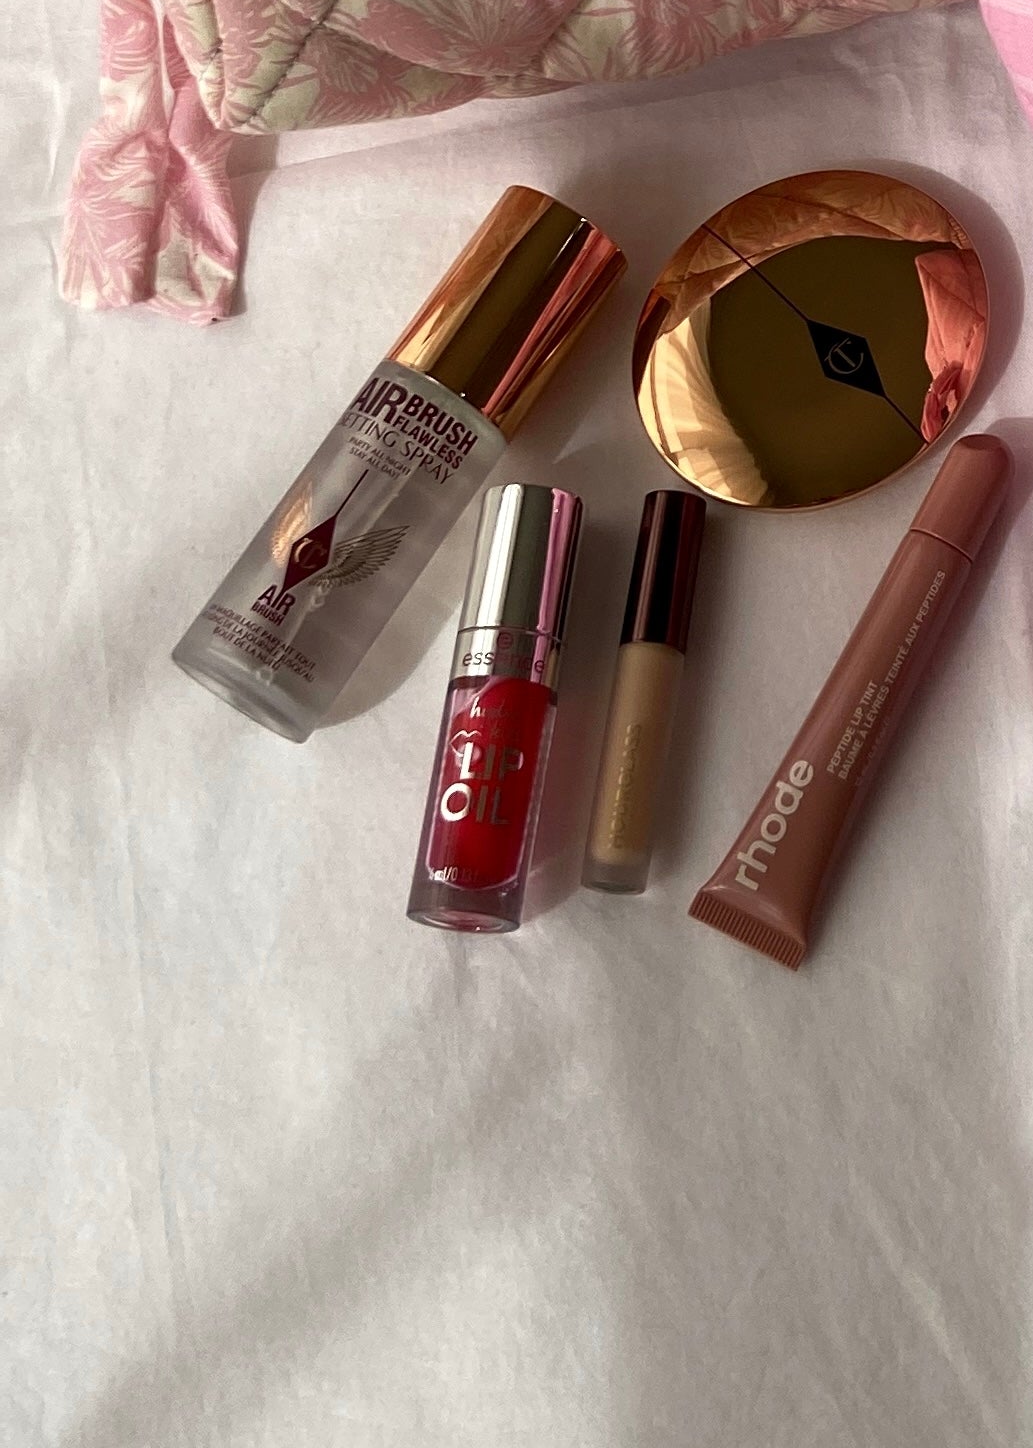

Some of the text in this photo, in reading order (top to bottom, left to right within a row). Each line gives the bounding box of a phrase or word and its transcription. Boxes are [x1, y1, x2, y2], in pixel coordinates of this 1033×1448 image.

[348, 436, 372, 451] PARTY
[372, 446, 387, 460] ALL
[349, 447, 366, 461] STAY
[367, 455, 381, 469] ALL
[392, 415, 463, 470] FLAWLESS
[400, 440, 455, 484] SPRAY
[250, 601, 285, 626] BRUSH
[257, 584, 296, 616] AIR
[462, 651, 545, 673] essnce
[838, 740, 864, 781] BAUME
[904, 622, 921, 648] AUX
[915, 570, 946, 624] PEPTIDES
[826, 726, 856, 774] PEPTIDE
[851, 705, 866, 727] LIP
[859, 679, 878, 706] TINT
[459, 741, 524, 781] LIP
[440, 782, 511, 825] OIL
[735, 760, 814, 891] rhode
